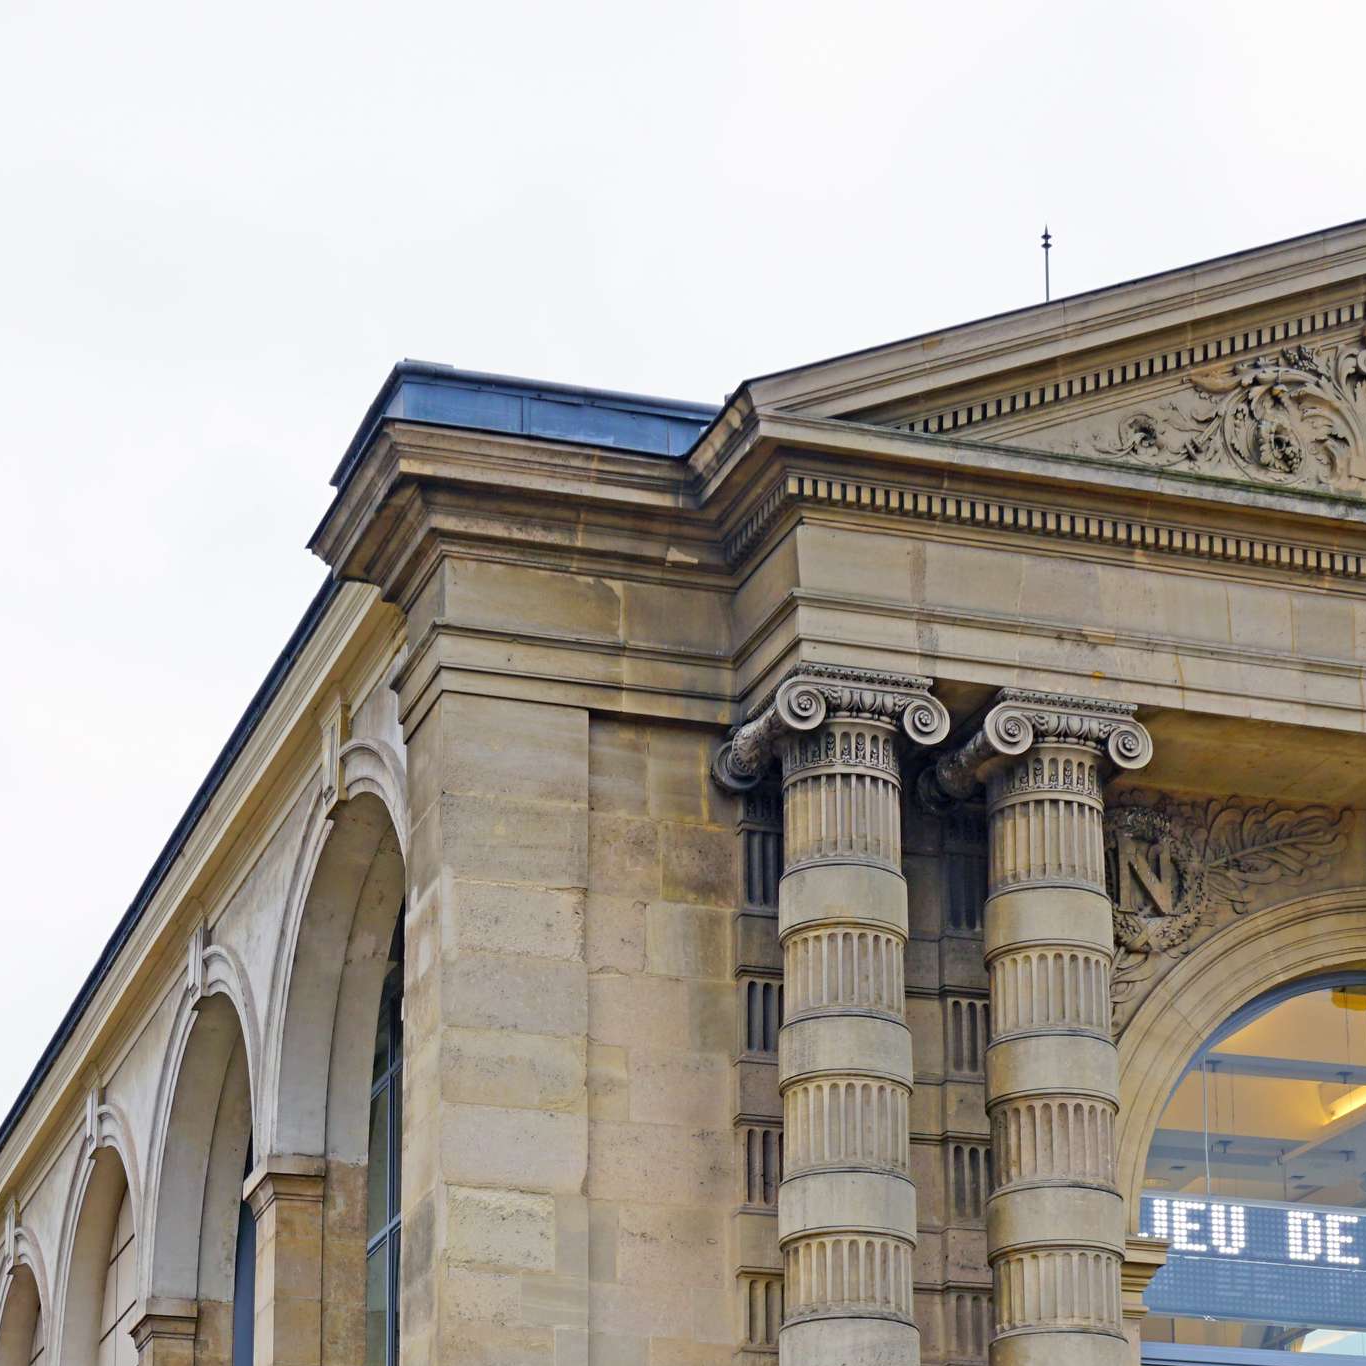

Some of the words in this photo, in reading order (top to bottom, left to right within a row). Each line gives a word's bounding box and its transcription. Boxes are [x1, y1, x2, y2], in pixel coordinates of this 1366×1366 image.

[1116, 836, 1178, 915] N
[1137, 1199, 1245, 1254] JEU
[1287, 1210, 1360, 1264] DE
